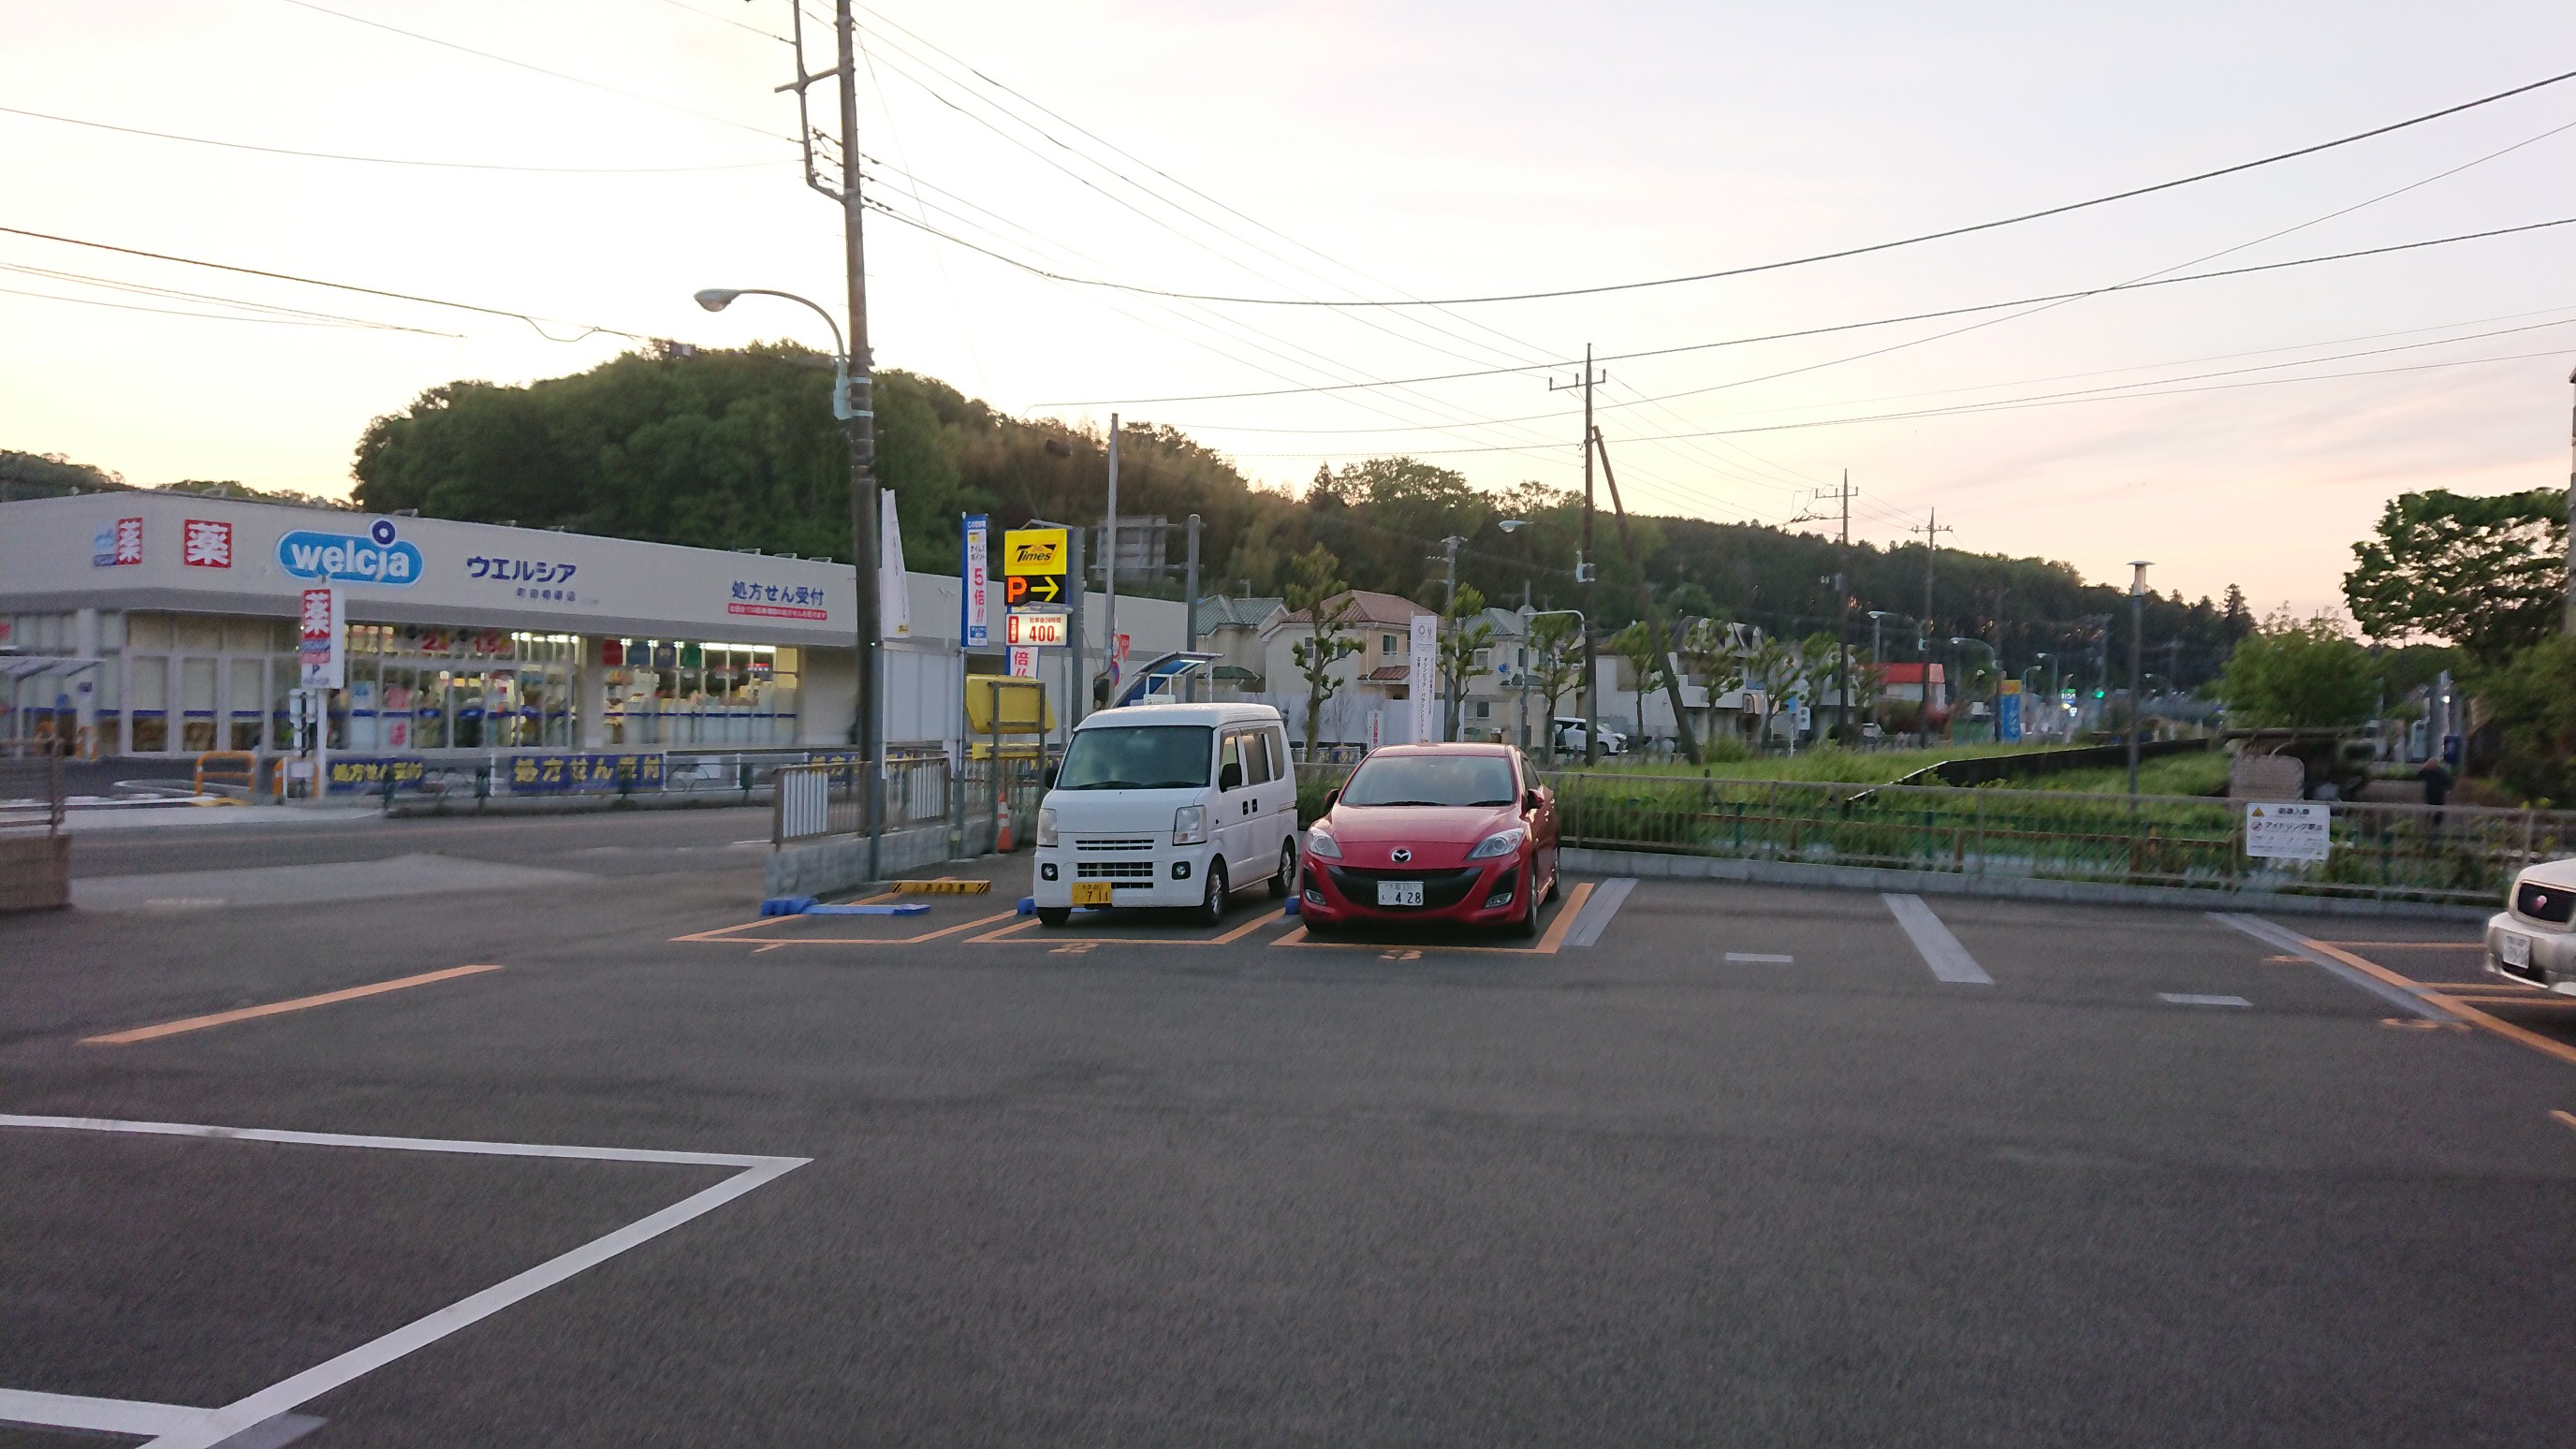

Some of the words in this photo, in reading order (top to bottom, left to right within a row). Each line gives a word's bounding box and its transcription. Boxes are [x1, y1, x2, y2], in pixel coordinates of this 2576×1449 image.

[119, 520, 140, 562] 薬
[187, 522, 228, 564] 薬
[291, 520, 410, 582] welcia
[1016, 544, 1057, 562] Times
[467, 556, 577, 583] ウエルシア
[732, 580, 825, 607] 処方せん受付
[1007, 577, 1028, 603] P
[304, 592, 329, 636] 薬
